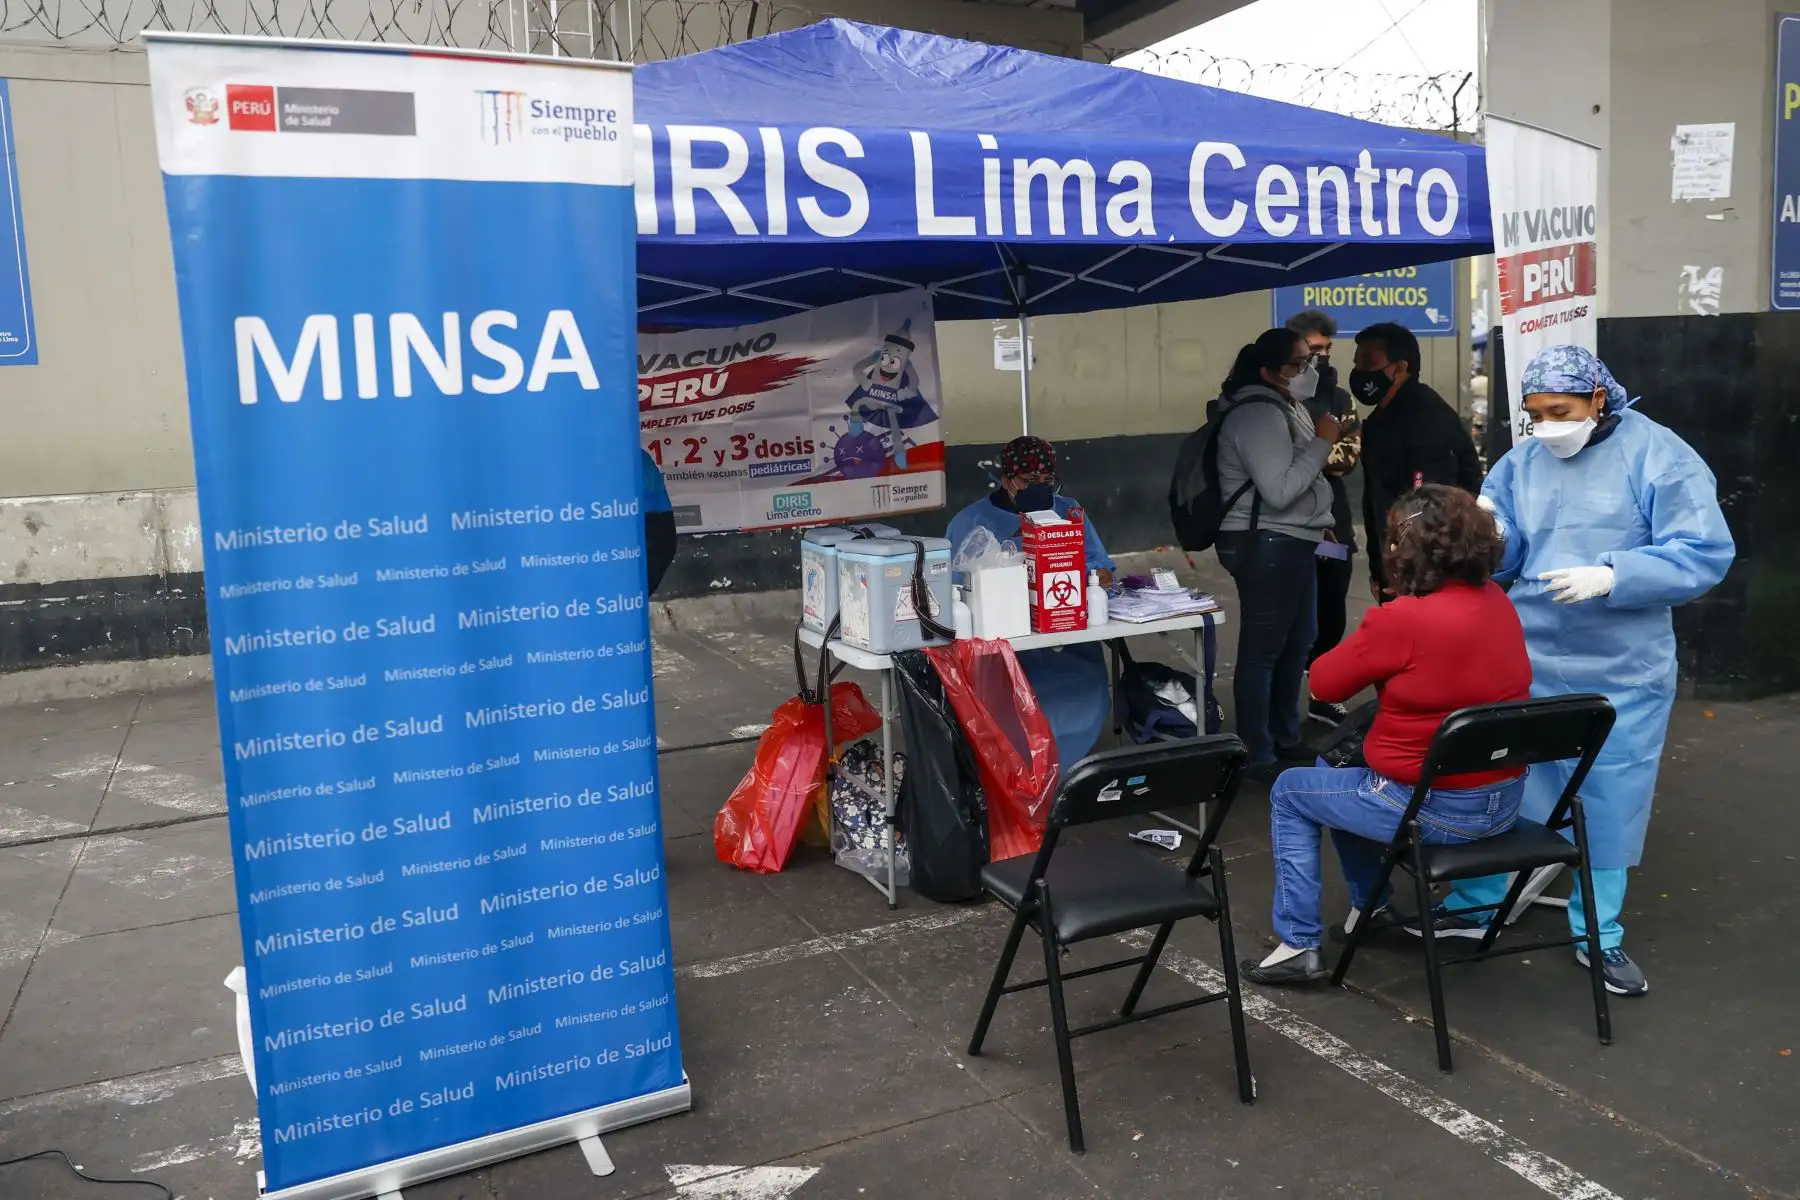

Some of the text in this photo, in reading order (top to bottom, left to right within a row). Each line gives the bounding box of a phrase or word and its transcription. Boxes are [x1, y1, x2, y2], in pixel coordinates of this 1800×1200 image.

[232, 99, 272, 116] PERÚ
[284, 103, 340, 116] Ministerio
[285, 115, 332, 127] de Salud
[531, 99, 617, 127] Siempre
[564, 124, 618, 142] pueblo
[912, 132, 1157, 239] Lima
[1190, 141, 1461, 237] Centro
[1523, 246, 1576, 302] PERÚ
[1304, 284, 1428, 307] PIROTÉCNICOS
[234, 309, 600, 404] MINSA
[638, 332, 777, 374] VACUNO
[870, 388, 897, 401] MINSA
[692, 408, 716, 423] TUS
[718, 401, 755, 417] DOSIS
[713, 449, 726, 467] y
[755, 436, 815, 459] dosis
[707, 468, 748, 479] vacunas
[750, 460, 812, 477] pediátricas!
[776, 494, 810, 510] DIRIS
[892, 484, 929, 495] Siempre
[904, 492, 929, 504] pueblo
[452, 498, 638, 530] Ministerio de Salud
[766, 507, 822, 521] Lima Centro
[215, 514, 428, 550] Ministerio de Salud
[376, 557, 506, 581] Ministerio de Salud
[521, 555, 588, 567] Ministerio
[592, 551, 608, 562] de
[220, 572, 358, 598] Ministerio de Salud
[459, 592, 642, 629] Ministerio de Salud
[225, 614, 435, 655] Ministerio de Salud
[385, 654, 512, 681] Ministerio de Salud
[527, 650, 594, 663] Ministerio
[598, 646, 613, 657] de
[230, 674, 366, 702] Ministerio de Salud
[466, 688, 648, 728] Ministerio de Salud
[235, 714, 443, 760] Ministerio de Salud
[534, 745, 600, 761] Ministerio
[604, 742, 619, 754] de
[394, 753, 520, 783] Ministerio de Salud
[240, 776, 375, 807] Ministerio de Salud
[474, 776, 653, 824] Ministerio de Salud
[245, 811, 451, 861] Ministerio de Salud
[541, 835, 605, 850] Ministerio
[609, 831, 624, 842] de
[402, 843, 526, 876] Ministerio de Salud
[250, 870, 384, 904] Ministerio de Salud
[481, 864, 659, 914] Ministerio de Salud
[256, 903, 458, 956] Ministerio de Salud
[548, 923, 611, 938] Ministerio
[615, 918, 630, 928] de
[411, 932, 533, 968] Ministerio de Salud
[260, 962, 392, 999] Ministerio de Salud
[488, 949, 665, 1004] Ministerio de Salud
[265, 994, 466, 1051] Ministerio de Salud
[556, 1010, 617, 1028] Ministerio
[621, 1005, 635, 1015] de
[420, 1023, 541, 1061] Ministerio de Salud
[270, 1056, 402, 1095] Ministerio de Salud
[496, 1032, 671, 1090] Ministerio de Salud
[275, 1082, 474, 1144] Ministerio de Salud
